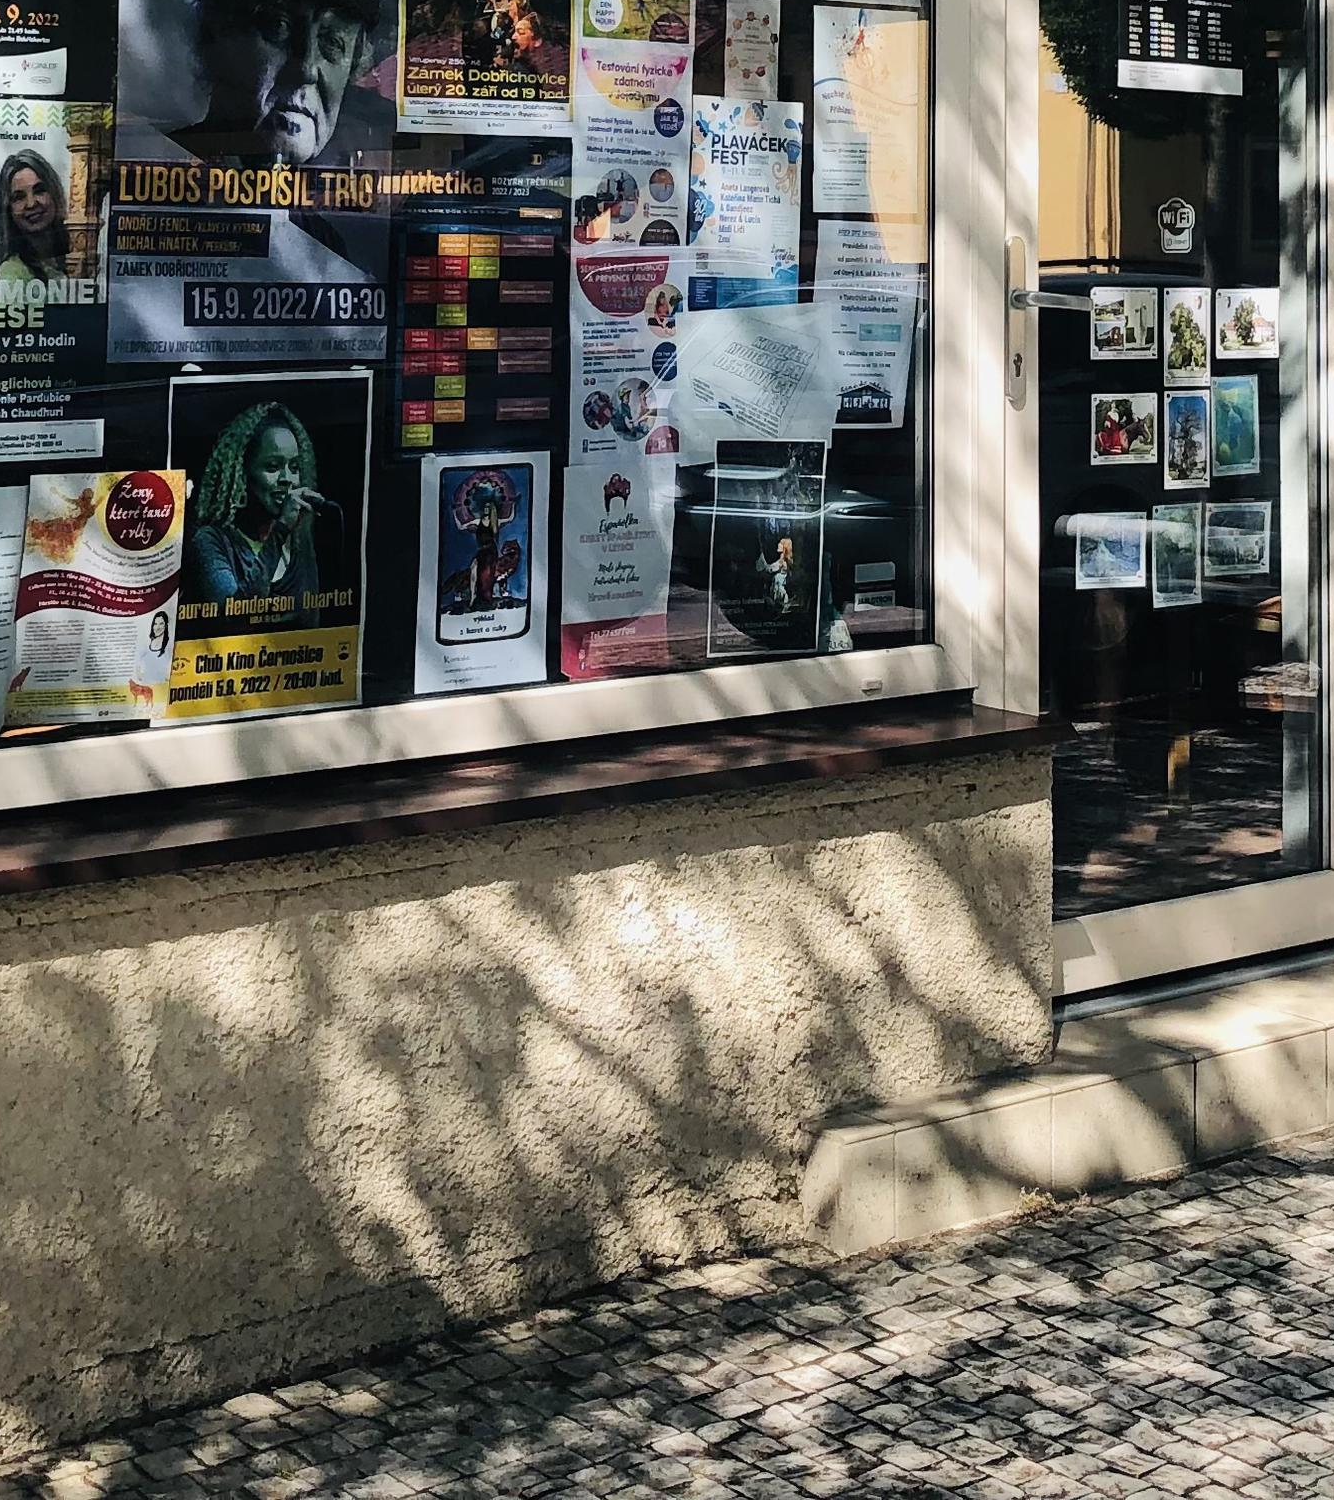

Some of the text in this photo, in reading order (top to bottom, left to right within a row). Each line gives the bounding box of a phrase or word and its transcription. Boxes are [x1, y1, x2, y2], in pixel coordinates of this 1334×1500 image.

[6, 4, 24, 25] 9.
[27, 12, 60, 27] 2022
[596, 60, 639, 74] Testování
[406, 66, 567, 86] Zámek Dobřichovice
[445, 83, 468, 96] 20.
[472, 84, 498, 97] září
[500, 86, 519, 99] od
[521, 88, 536, 99] 19
[21, 130, 47, 142] uvádí
[711, 132, 788, 153] PLAVÁČEK
[710, 149, 748, 166] FEST
[118, 158, 374, 208] LUBOŠ POSPÍŠIL TRIO
[491, 176, 524, 186] ROZVRH
[491, 187, 530, 196] 2022 2023
[117, 215, 191, 233] ONDŘEJ FENCL
[117, 235, 198, 252] MICHAL HNÁTEK
[115, 258, 229, 278] ZÁMEK DOBŘICHOVICE
[191, 286, 386, 321] 15.9. 2022 19:30
[2, 337, 10, 348] v
[15, 333, 35, 347] 19
[38, 332, 76, 347] hodin
[10, 351, 55, 364] ŘEVNICE
[19, 391, 71, 404] Pardubice
[10, 406, 64, 419] Chaudhuri
[118, 480, 155, 505] Ženy,
[109, 503, 173, 520] které tančí
[120, 521, 154, 545] s vlky
[178, 587, 354, 621] auren Henderson Quartet
[195, 644, 324, 675] Club Kino Černošice
[169, 678, 213, 705] pondělí
[240, 674, 271, 695] 2022
[283, 671, 318, 690] 20:00
